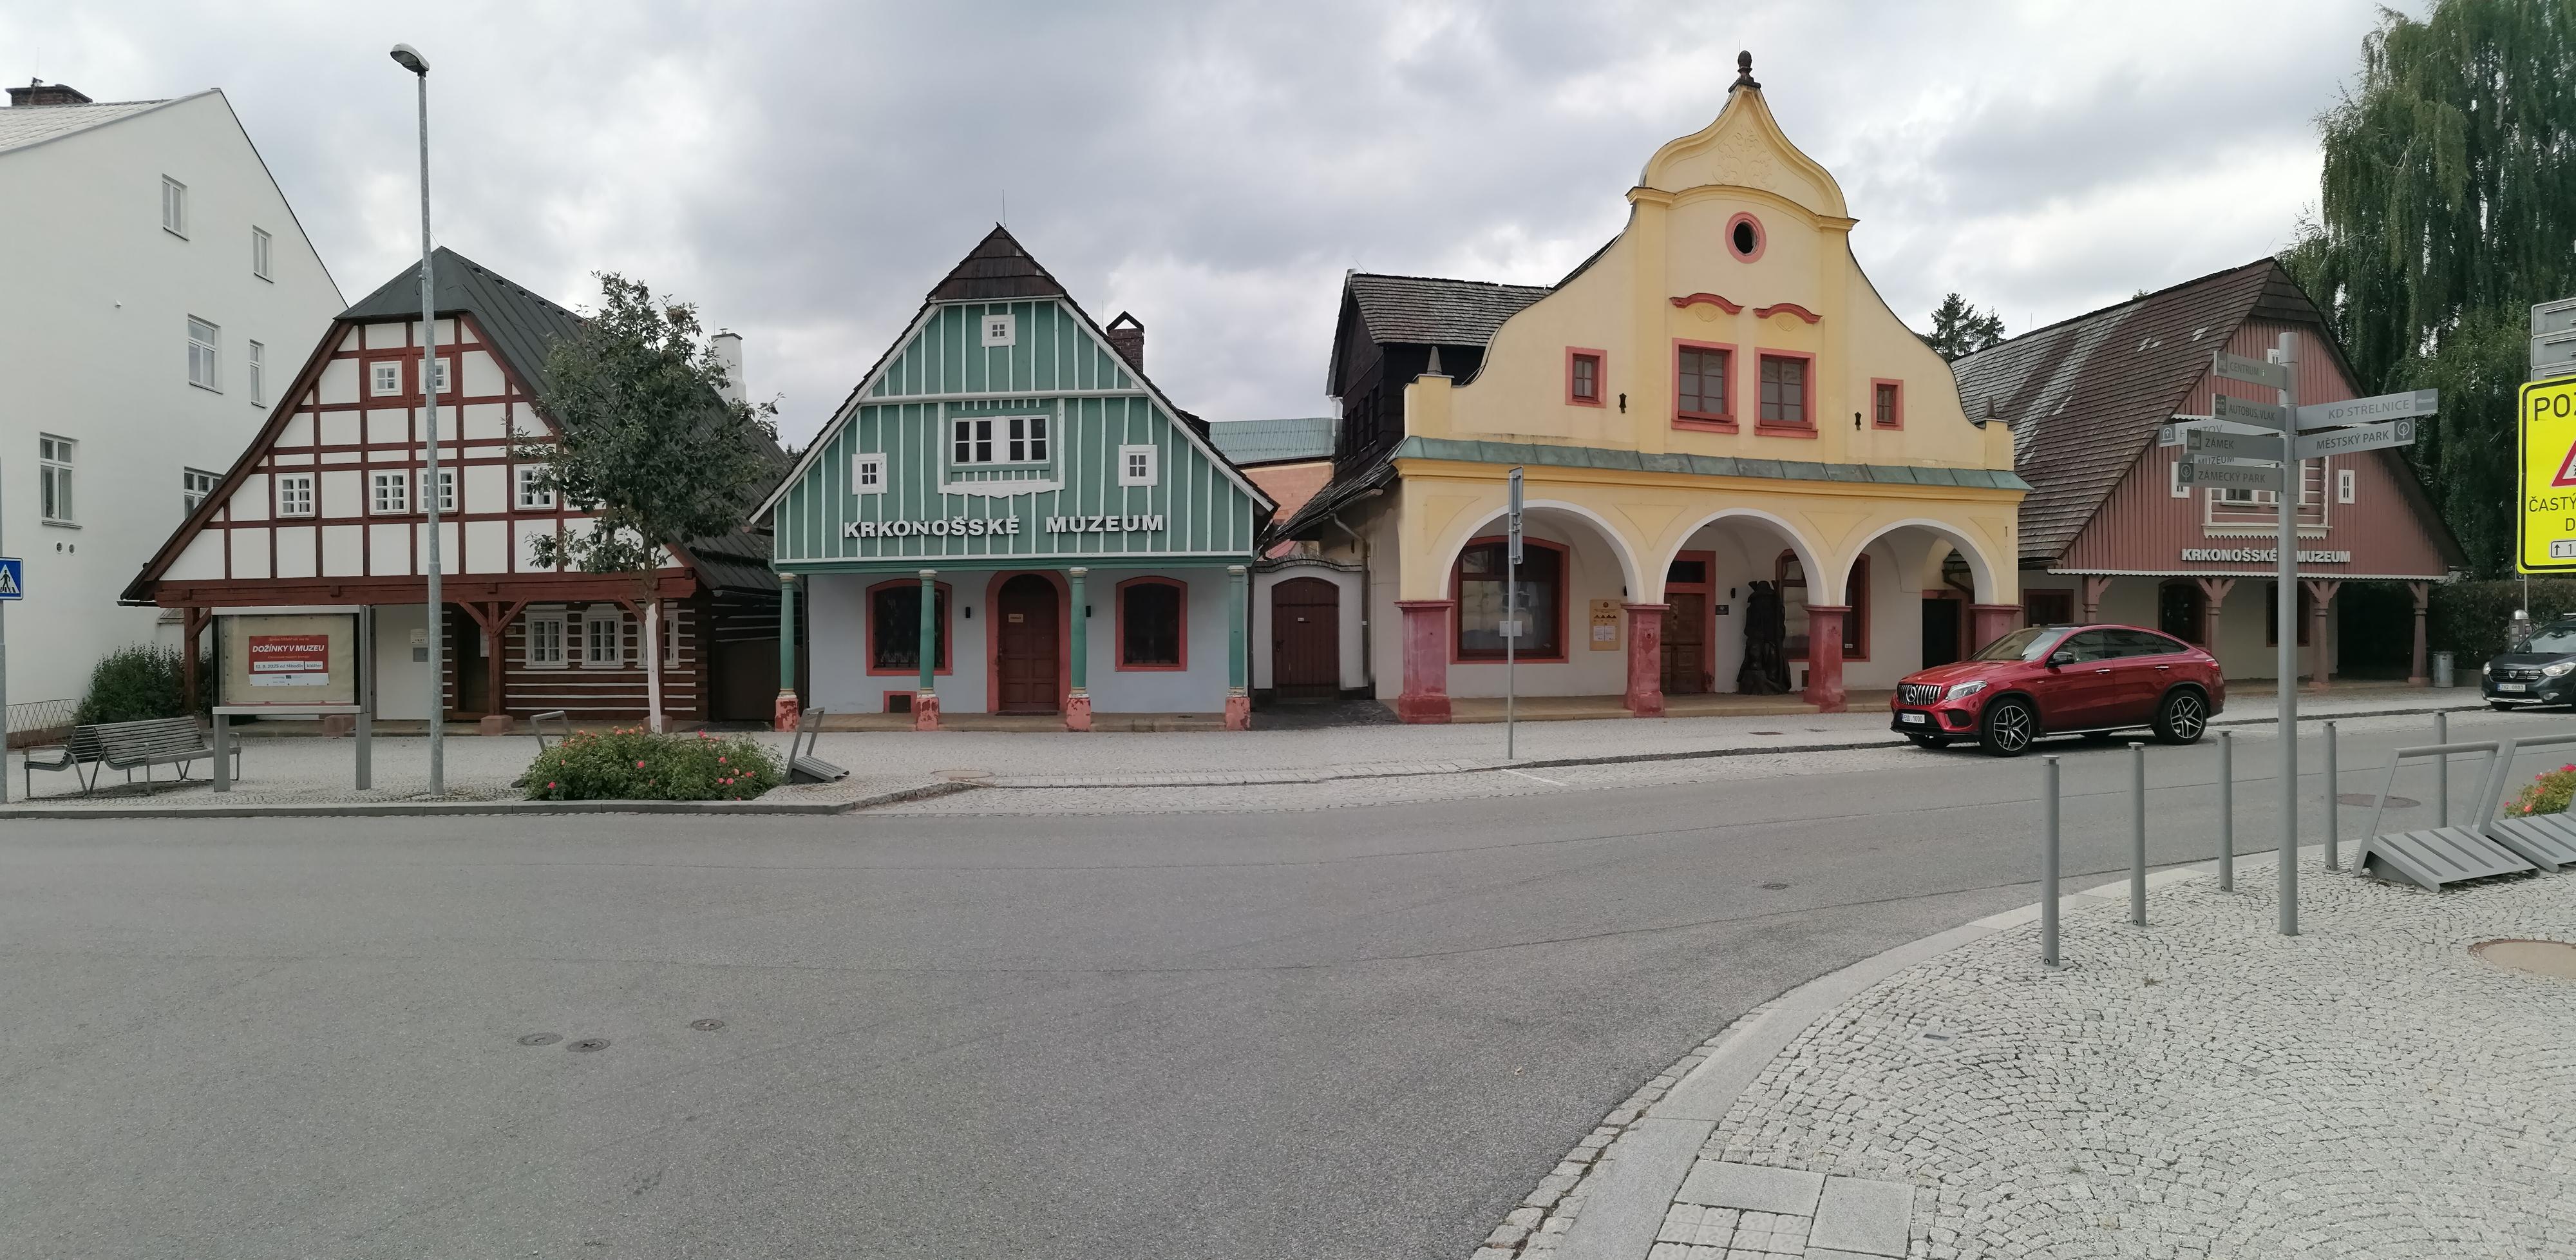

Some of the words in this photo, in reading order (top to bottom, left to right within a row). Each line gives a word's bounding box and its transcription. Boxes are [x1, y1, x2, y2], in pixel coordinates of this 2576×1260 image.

[2230, 362, 2259, 376] CENTRUM
[2329, 408, 2344, 419] KD
[2347, 399, 2410, 417] STŘELNICE
[2534, 392, 2576, 422] PO
[2205, 436, 2234, 450] ZÁMEK
[2316, 433, 2360, 450] MĚSTSKÝ
[2363, 430, 2389, 443] PARK
[2198, 456, 2235, 464] MUZEUM
[2198, 469, 2240, 482] ZÁMECKÝ
[2243, 473, 2266, 483] PARK
[844, 516, 1019, 538] KRKONOŠSKÉ
[1046, 514, 1164, 533] MUZEUM
[2181, 548, 2278, 562] KRKONOŠSKÉ
[2297, 550, 2351, 562] MUZEUM
[252, 644, 289, 653] DOŽÍNKY
